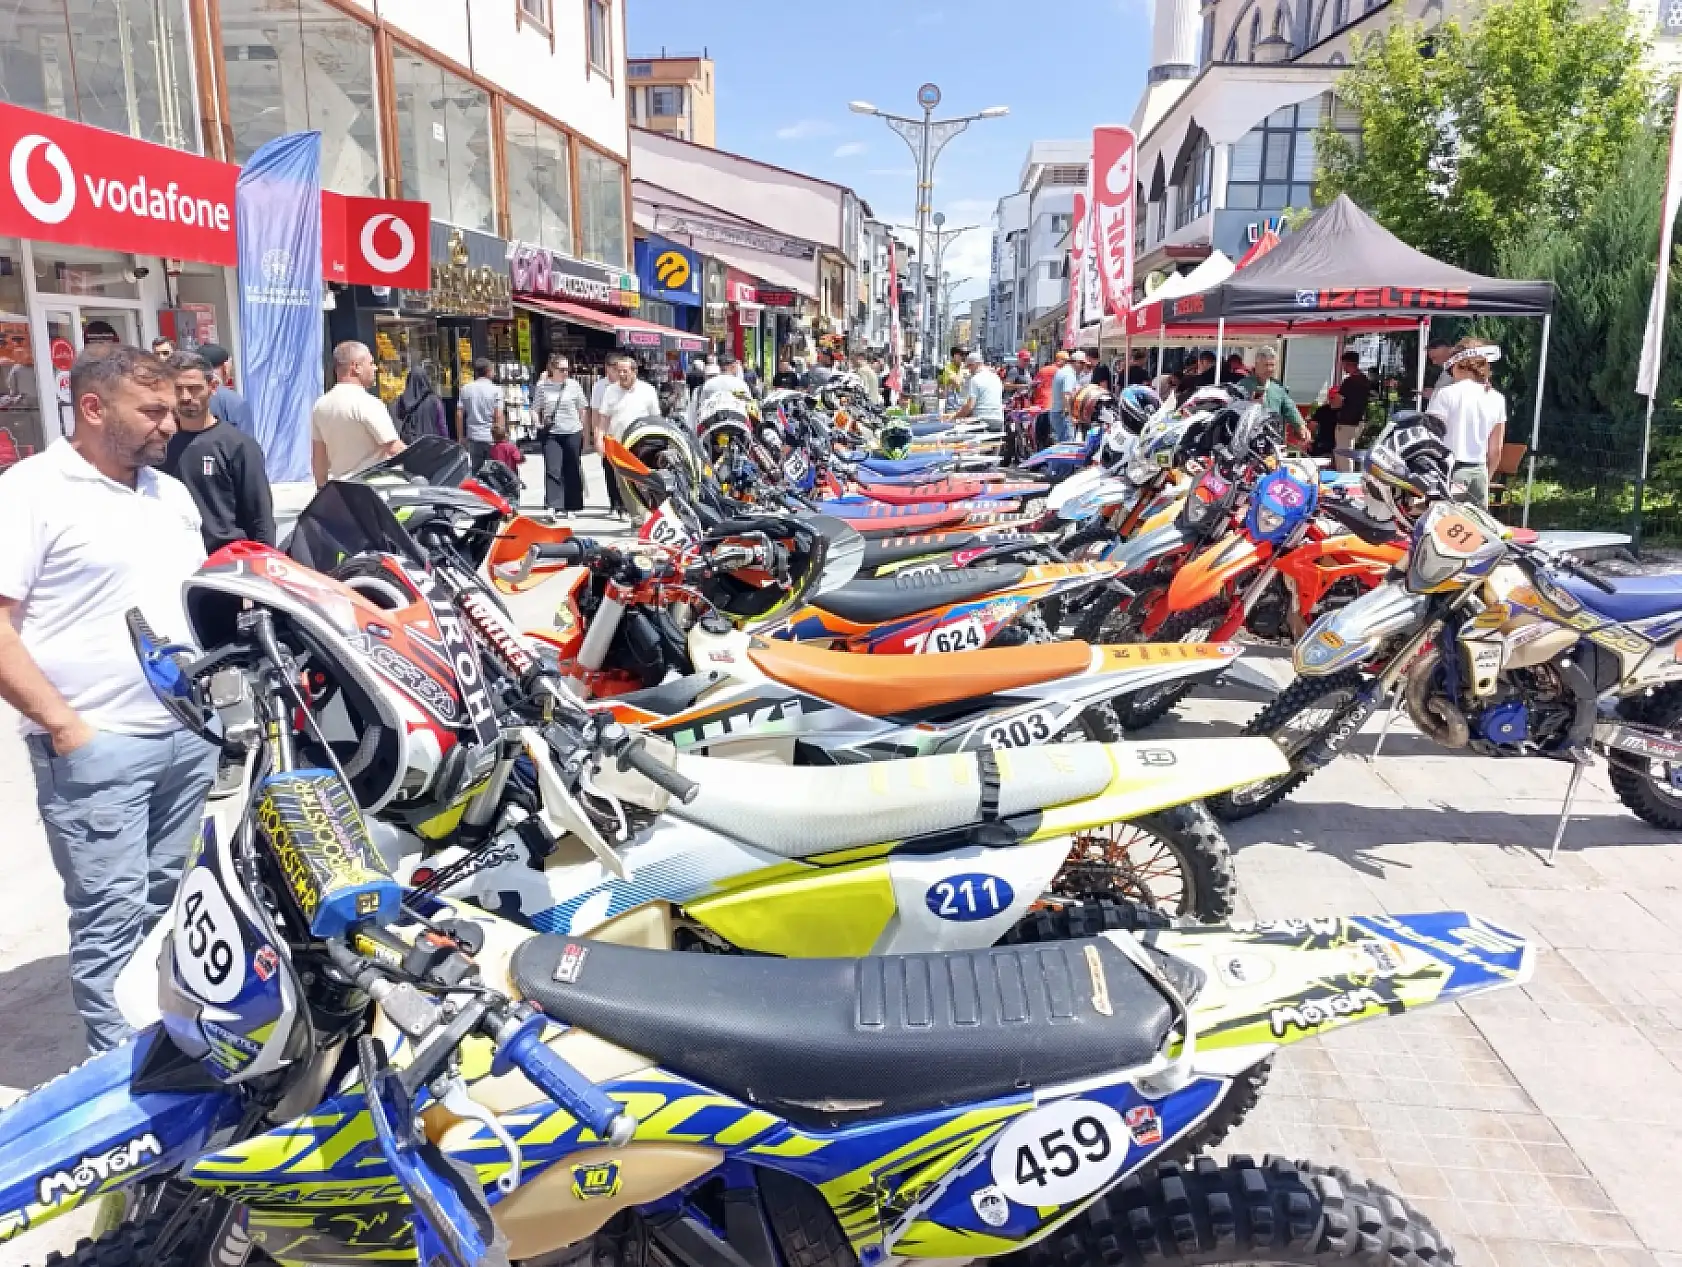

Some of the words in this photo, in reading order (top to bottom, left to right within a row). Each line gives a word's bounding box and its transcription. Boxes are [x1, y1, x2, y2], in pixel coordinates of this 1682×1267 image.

[84, 175, 231, 232] vodafone
[1447, 523, 1473, 545] 81
[937, 626, 981, 653] 624
[990, 713, 1051, 749] 303
[935, 876, 1004, 916] 211
[184, 889, 234, 986] 459
[1270, 988, 1387, 1038] MOTOM
[40, 1133, 163, 1204] MOTOM
[1016, 1116, 1112, 1187] 459
[585, 1170, 609, 1187] 10
